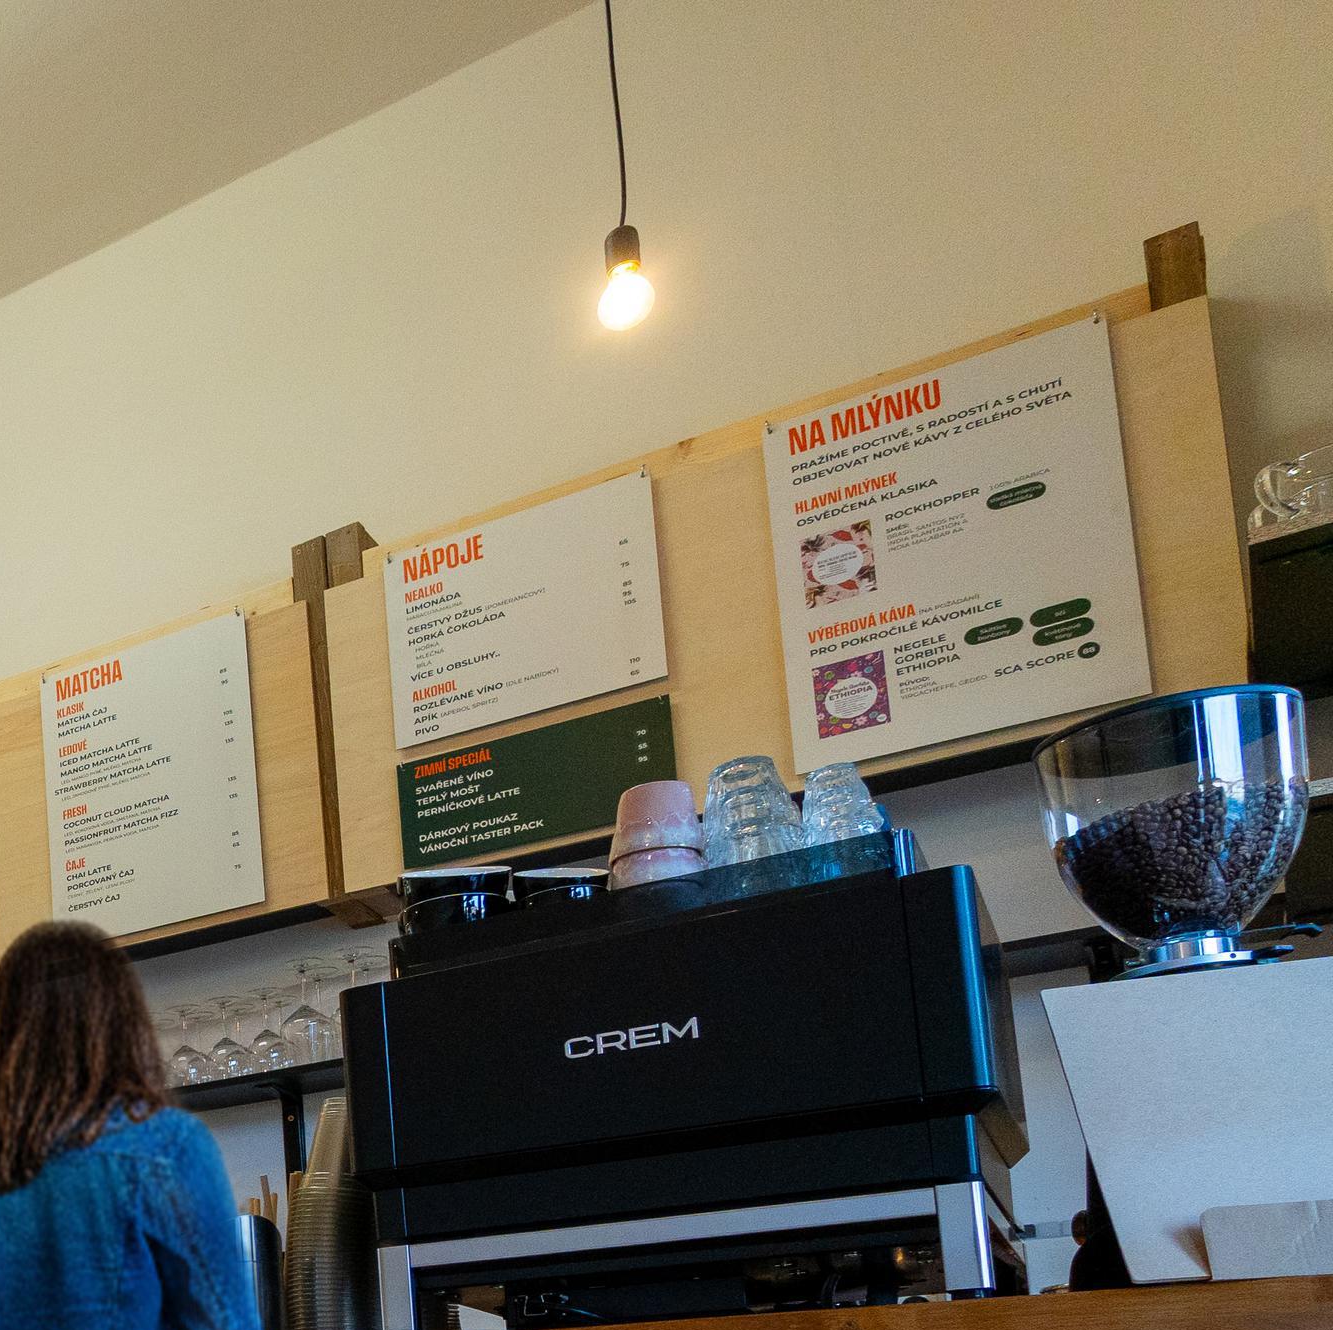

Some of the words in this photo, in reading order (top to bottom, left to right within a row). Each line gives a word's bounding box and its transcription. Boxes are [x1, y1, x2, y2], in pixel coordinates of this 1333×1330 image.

[788, 419, 826, 456] NA
[831, 379, 941, 441] MLÝNKU
[791, 448, 848, 473] PRAŽÍME
[916, 424, 924, 433] S
[928, 401, 989, 428] RADOSTÍ
[992, 399, 1003, 408] A
[1006, 394, 1015, 403] S
[1018, 377, 1062, 399] CHUTÍ
[792, 455, 869, 486] OBJEVOVAT
[873, 442, 910, 460] NOVÉ
[913, 429, 949, 447] KÁVY
[953, 425, 962, 435] Z
[965, 406, 1022, 431] CELÉHO
[1025, 391, 1072, 412] SVĚTA
[795, 486, 842, 515] HLAVNÍ
[845, 471, 898, 500] MLÝNEK
[796, 496, 877, 527] OSVĚDČENÁ
[881, 478, 938, 501] KLASIKA
[885, 487, 980, 522] ROCKHOPPER
[402, 533, 484, 584] NÁPOJE
[404, 581, 443, 604] NEALKO
[406, 592, 461, 614] LIMONÁDA
[407, 615, 452, 635] ČERSTVÝ
[454, 606, 483, 620] DŽUS
[408, 630, 444, 647] HORKÁ
[447, 611, 506, 634] ČOKOLÁDA
[808, 612, 877, 644] VÝBĚROVÁ
[879, 603, 916, 625] KÁVA
[810, 644, 838, 657] PRO
[841, 621, 917, 650] POKROČILÉ
[921, 599, 1003, 628] KÁVOMILCE
[893, 634, 947, 654] NEGELE
[894, 642, 956, 665] GORBITU
[410, 669, 434, 682] VÍCE
[436, 667, 444, 675] U
[896, 653, 961, 676] ETHIOPIA
[994, 664, 1022, 678] SCA
[1026, 650, 1075, 669] SCORE
[55, 659, 123, 702] MATCHA
[412, 679, 457, 703] ALKOHOL
[829, 685, 873, 701] ETHIOPIA
[56, 701, 84, 719] KLASIK
[413, 690, 475, 713] ROZLÉVANÉ
[476, 682, 503, 695] VÍNO
[57, 713, 90, 728] MATCHA
[92, 707, 108, 717] ČAJ
[58, 723, 91, 738] MATCHA
[92, 714, 118, 727] LATTE
[413, 713, 438, 726] APÍK
[415, 724, 440, 736] PIVO
[58, 738, 88, 758] LEDOVÉ
[59, 756, 79, 768] ICED
[80, 744, 114, 760] MATCHA
[115, 737, 140, 751] LATTE
[60, 763, 91, 778] MANGO
[92, 752, 127, 768] MATCHA
[127, 744, 153, 757] LATTE
[54, 775, 109, 796] STRAWBERRY
[109, 764, 144, 780] MATCHA
[146, 756, 171, 769] LATTE
[414, 760, 446, 779] ZIMNÍ
[448, 748, 492, 770] SPECIÁL
[416, 791, 448, 806] TEPLÝ
[450, 784, 481, 799] MOŠT
[637, 742, 647, 750] 55
[415, 775, 464, 795] SVAŘENÉ
[466, 769, 494, 782] VÍNO
[417, 796, 485, 819] PERNÍČKOVÉ
[487, 787, 521, 802] LATTE
[637, 755, 648, 763] 95
[62, 804, 87, 820] FRESH
[63, 813, 102, 830] COCONUT
[104, 805, 132, 818] CLOUD
[134, 794, 169, 810] MATCHA
[64, 825, 122, 846] PASSIONFRUIT
[123, 815, 158, 830] MATCHA
[160, 808, 179, 820] FIZZ
[419, 822, 470, 842] DÁRKOVÝ
[472, 812, 518, 830] POUKAZ
[419, 835, 468, 854] VÁNOČNÍ
[470, 827, 511, 843] TASTER
[513, 819, 544, 833] PACK
[65, 857, 86, 872] ČAJE
[66, 872, 86, 882] CHAI
[87, 865, 112, 876] LATTE
[67, 872, 117, 892] PORCOVANÝ
[118, 869, 135, 878] ČAJ
[68, 897, 103, 912] ČERSTVÝ
[104, 893, 121, 903] ČAJ
[564, 1015, 700, 1060] CREM
